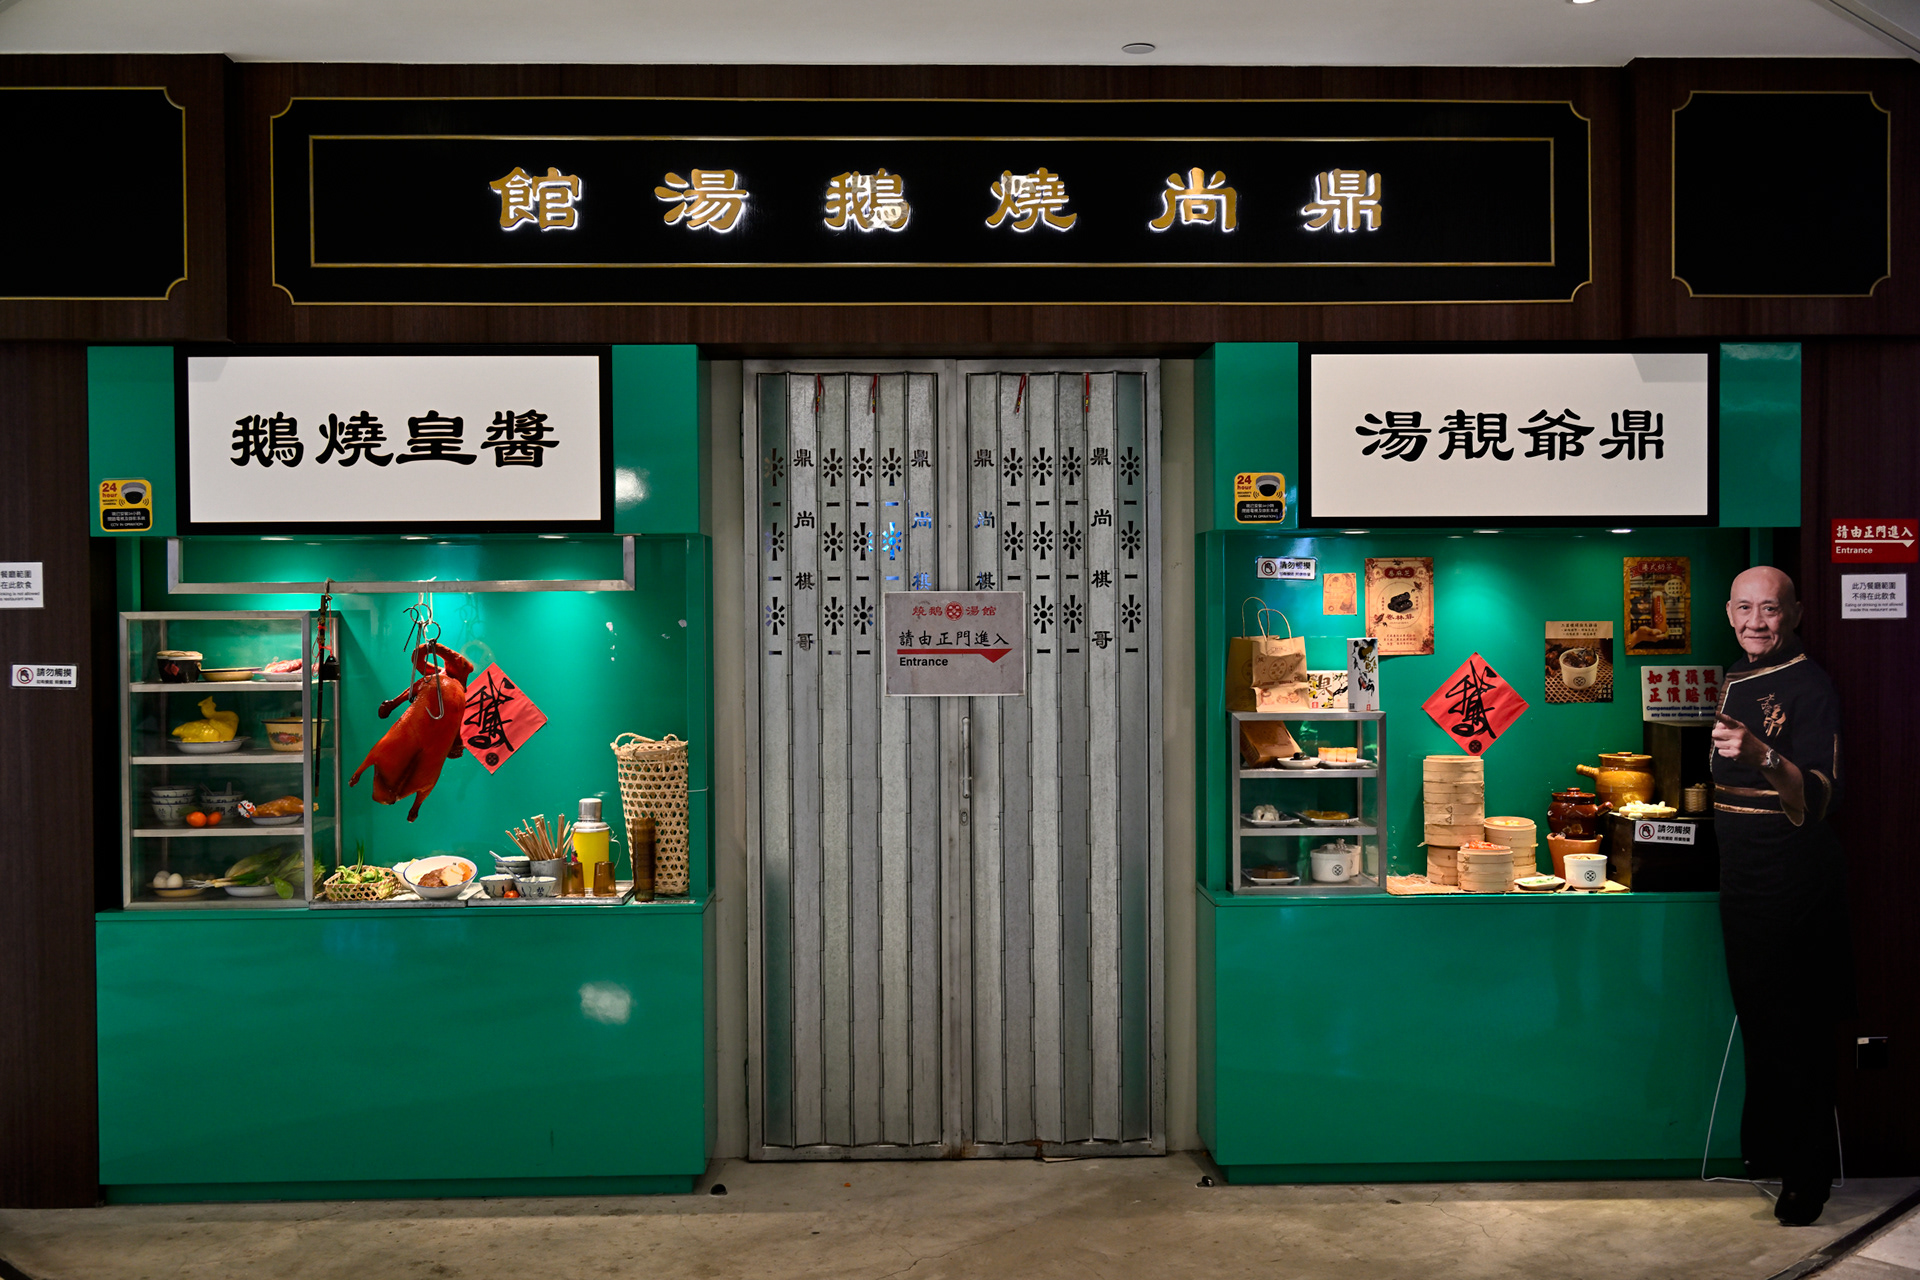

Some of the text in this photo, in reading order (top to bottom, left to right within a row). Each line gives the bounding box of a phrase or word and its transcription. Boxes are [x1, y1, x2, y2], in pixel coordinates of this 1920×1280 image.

[1237, 475, 1252, 485] 24
[102, 483, 117, 492] 24
[1836, 525, 1913, 539] 請由正門進入
[1836, 546, 1873, 554] Entrance
[1, 581, 32, 589] 在此飲食
[1852, 592, 1896, 600] 不得在此飲食
[899, 630, 1009, 647] 請由正門進入
[899, 657, 949, 667] Entrance
